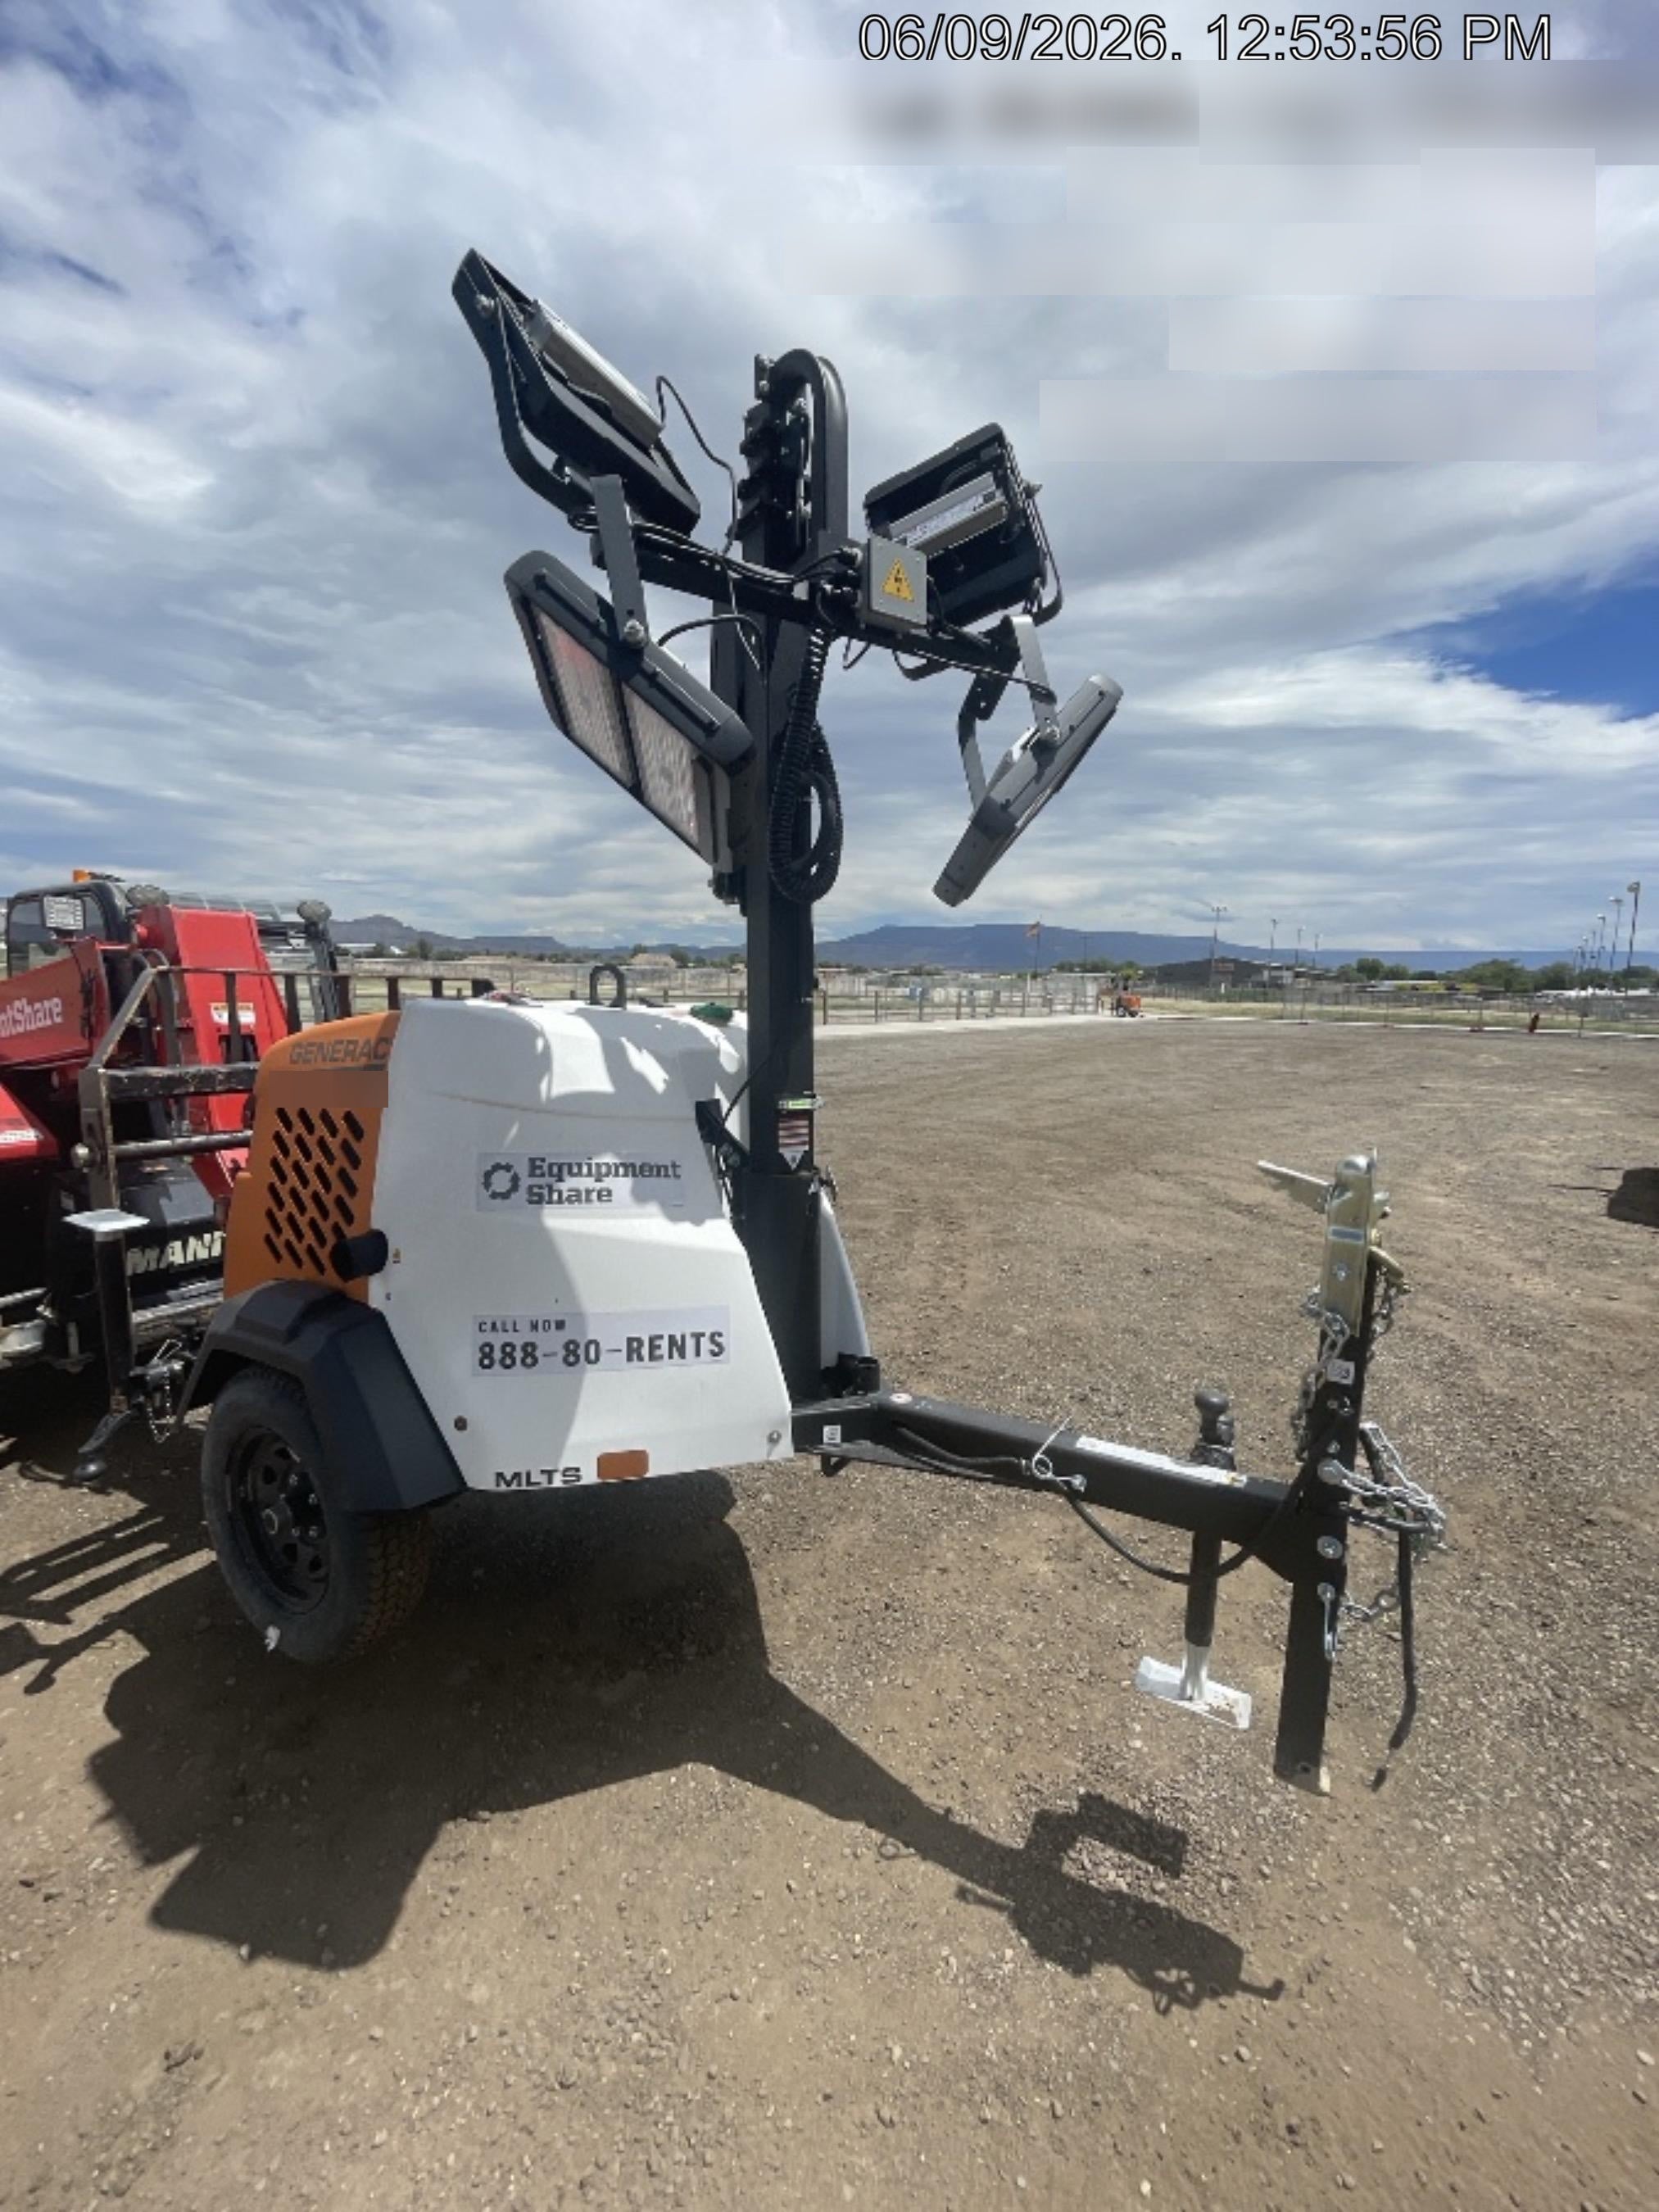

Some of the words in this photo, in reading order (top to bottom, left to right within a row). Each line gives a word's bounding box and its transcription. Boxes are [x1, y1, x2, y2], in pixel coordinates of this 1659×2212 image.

[289, 1036, 393, 1064] GENERAC
[528, 1157, 682, 1182] Equipment
[526, 1184, 613, 1205] Share
[126, 1230, 227, 1277] MANI
[478, 1321, 520, 1333] CALL
[530, 1319, 566, 1332] NOW
[478, 1331, 726, 1370] 888-80-RENTS
[495, 1466, 582, 1488] MLTS
